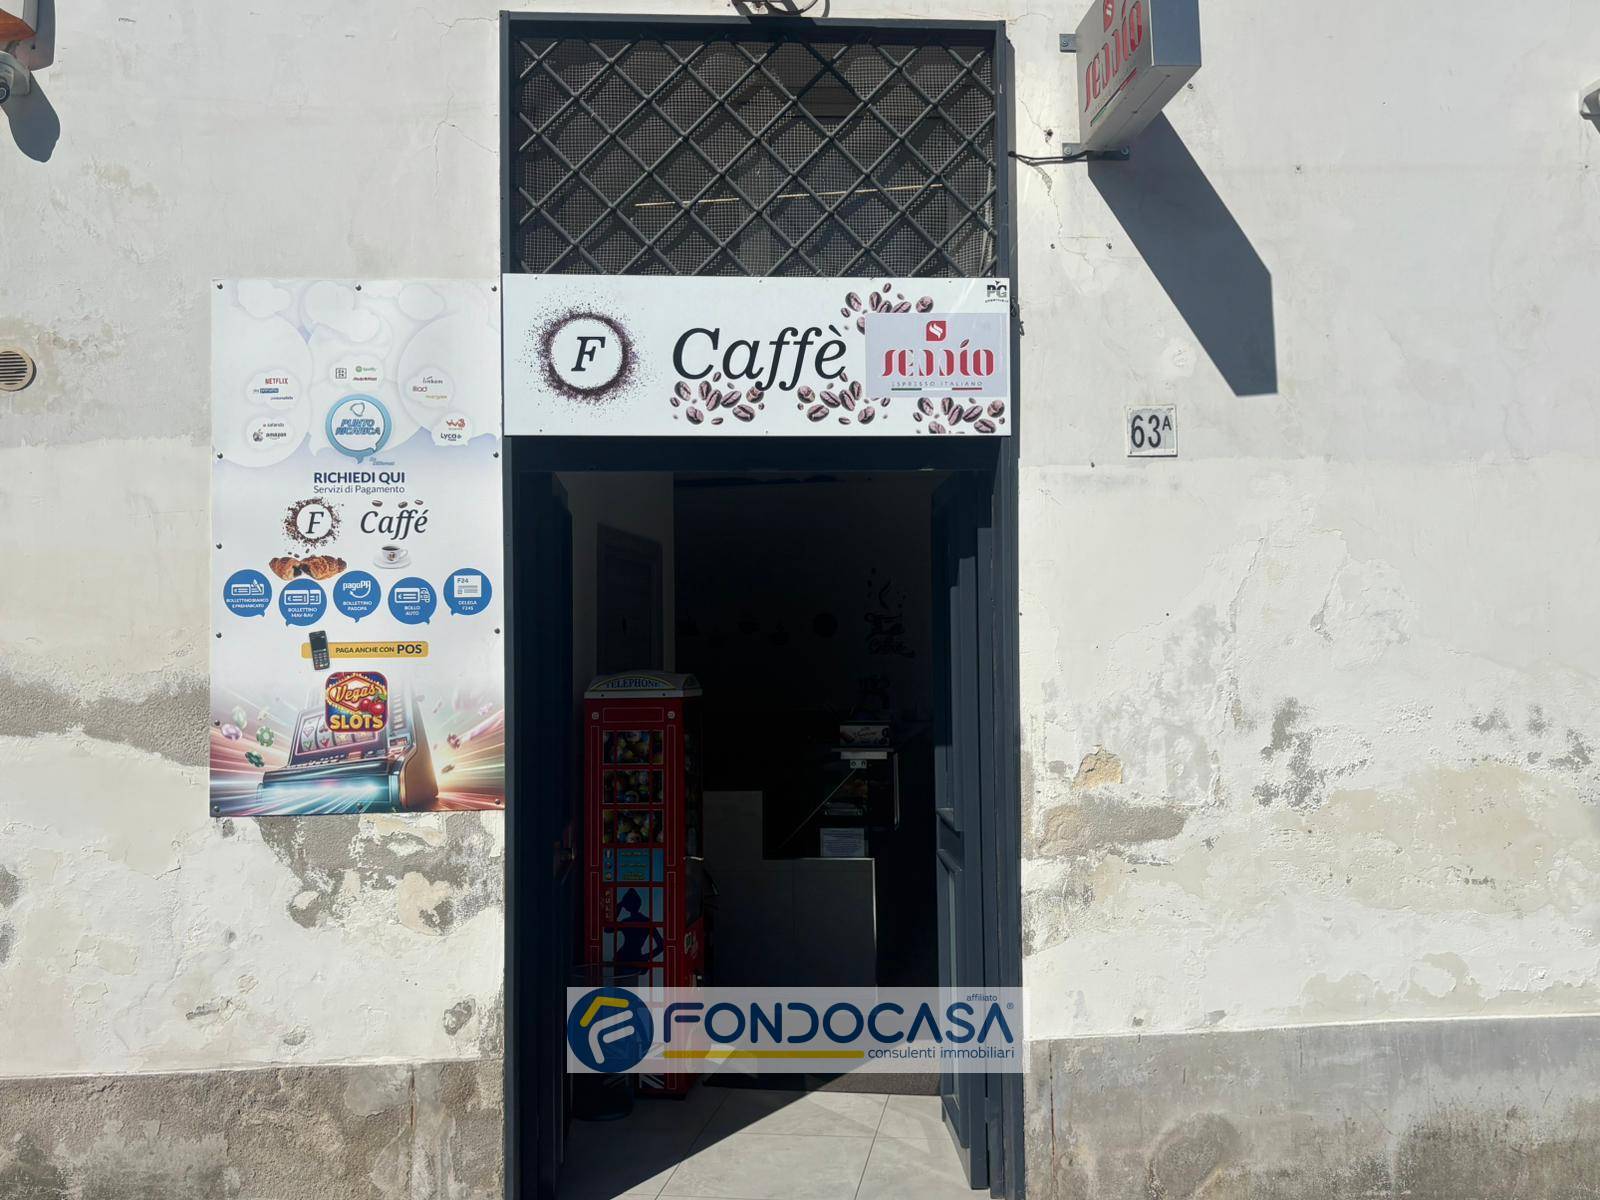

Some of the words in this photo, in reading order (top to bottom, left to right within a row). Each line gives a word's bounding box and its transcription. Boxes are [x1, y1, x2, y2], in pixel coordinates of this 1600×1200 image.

[571, 336, 605, 372] F
[673, 325, 847, 392] Caffè
[341, 419, 375, 427] PUNTO
[314, 472, 375, 483] RICHIEDI
[379, 472, 405, 484] QUI
[313, 485, 343, 494] Servizi
[345, 485, 353, 493] di
[355, 486, 405, 495] Pagamento
[305, 511, 324, 534] F
[343, 580, 371, 591] pagoPA
[397, 644, 422, 655] POS
[335, 684, 377, 703] Vegas
[330, 714, 384, 730] SLOTS
